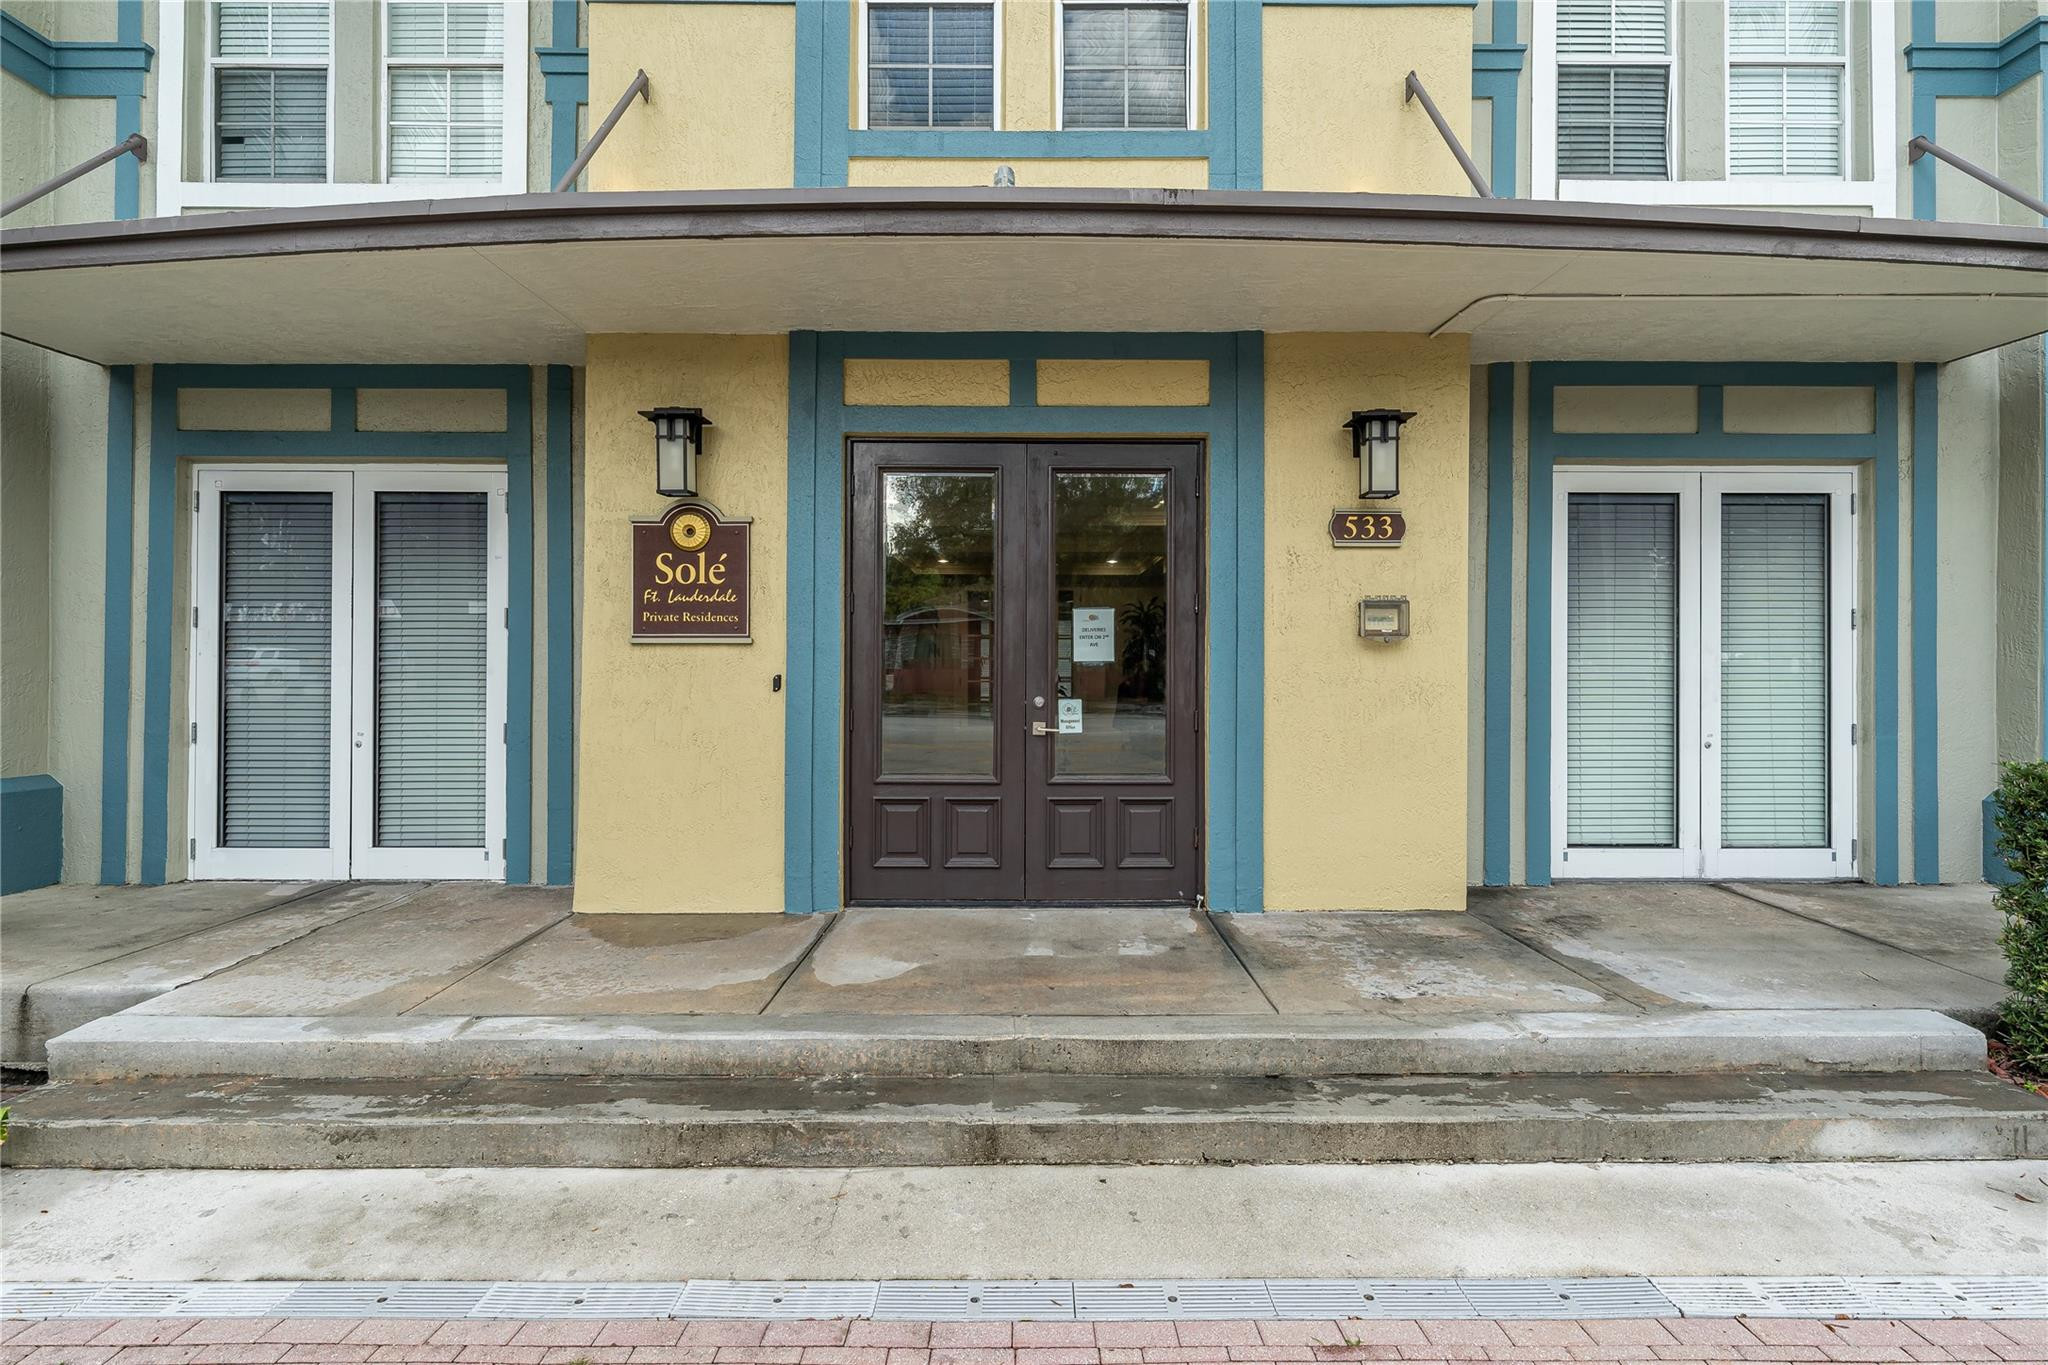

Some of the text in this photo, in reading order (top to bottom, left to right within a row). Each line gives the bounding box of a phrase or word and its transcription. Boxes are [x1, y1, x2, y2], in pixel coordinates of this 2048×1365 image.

[1343, 515, 1393, 539] 533
[655, 552, 727, 585] Solé
[643, 589, 738, 604] Ft. Lauderdale
[643, 612, 739, 622] Private Residences
